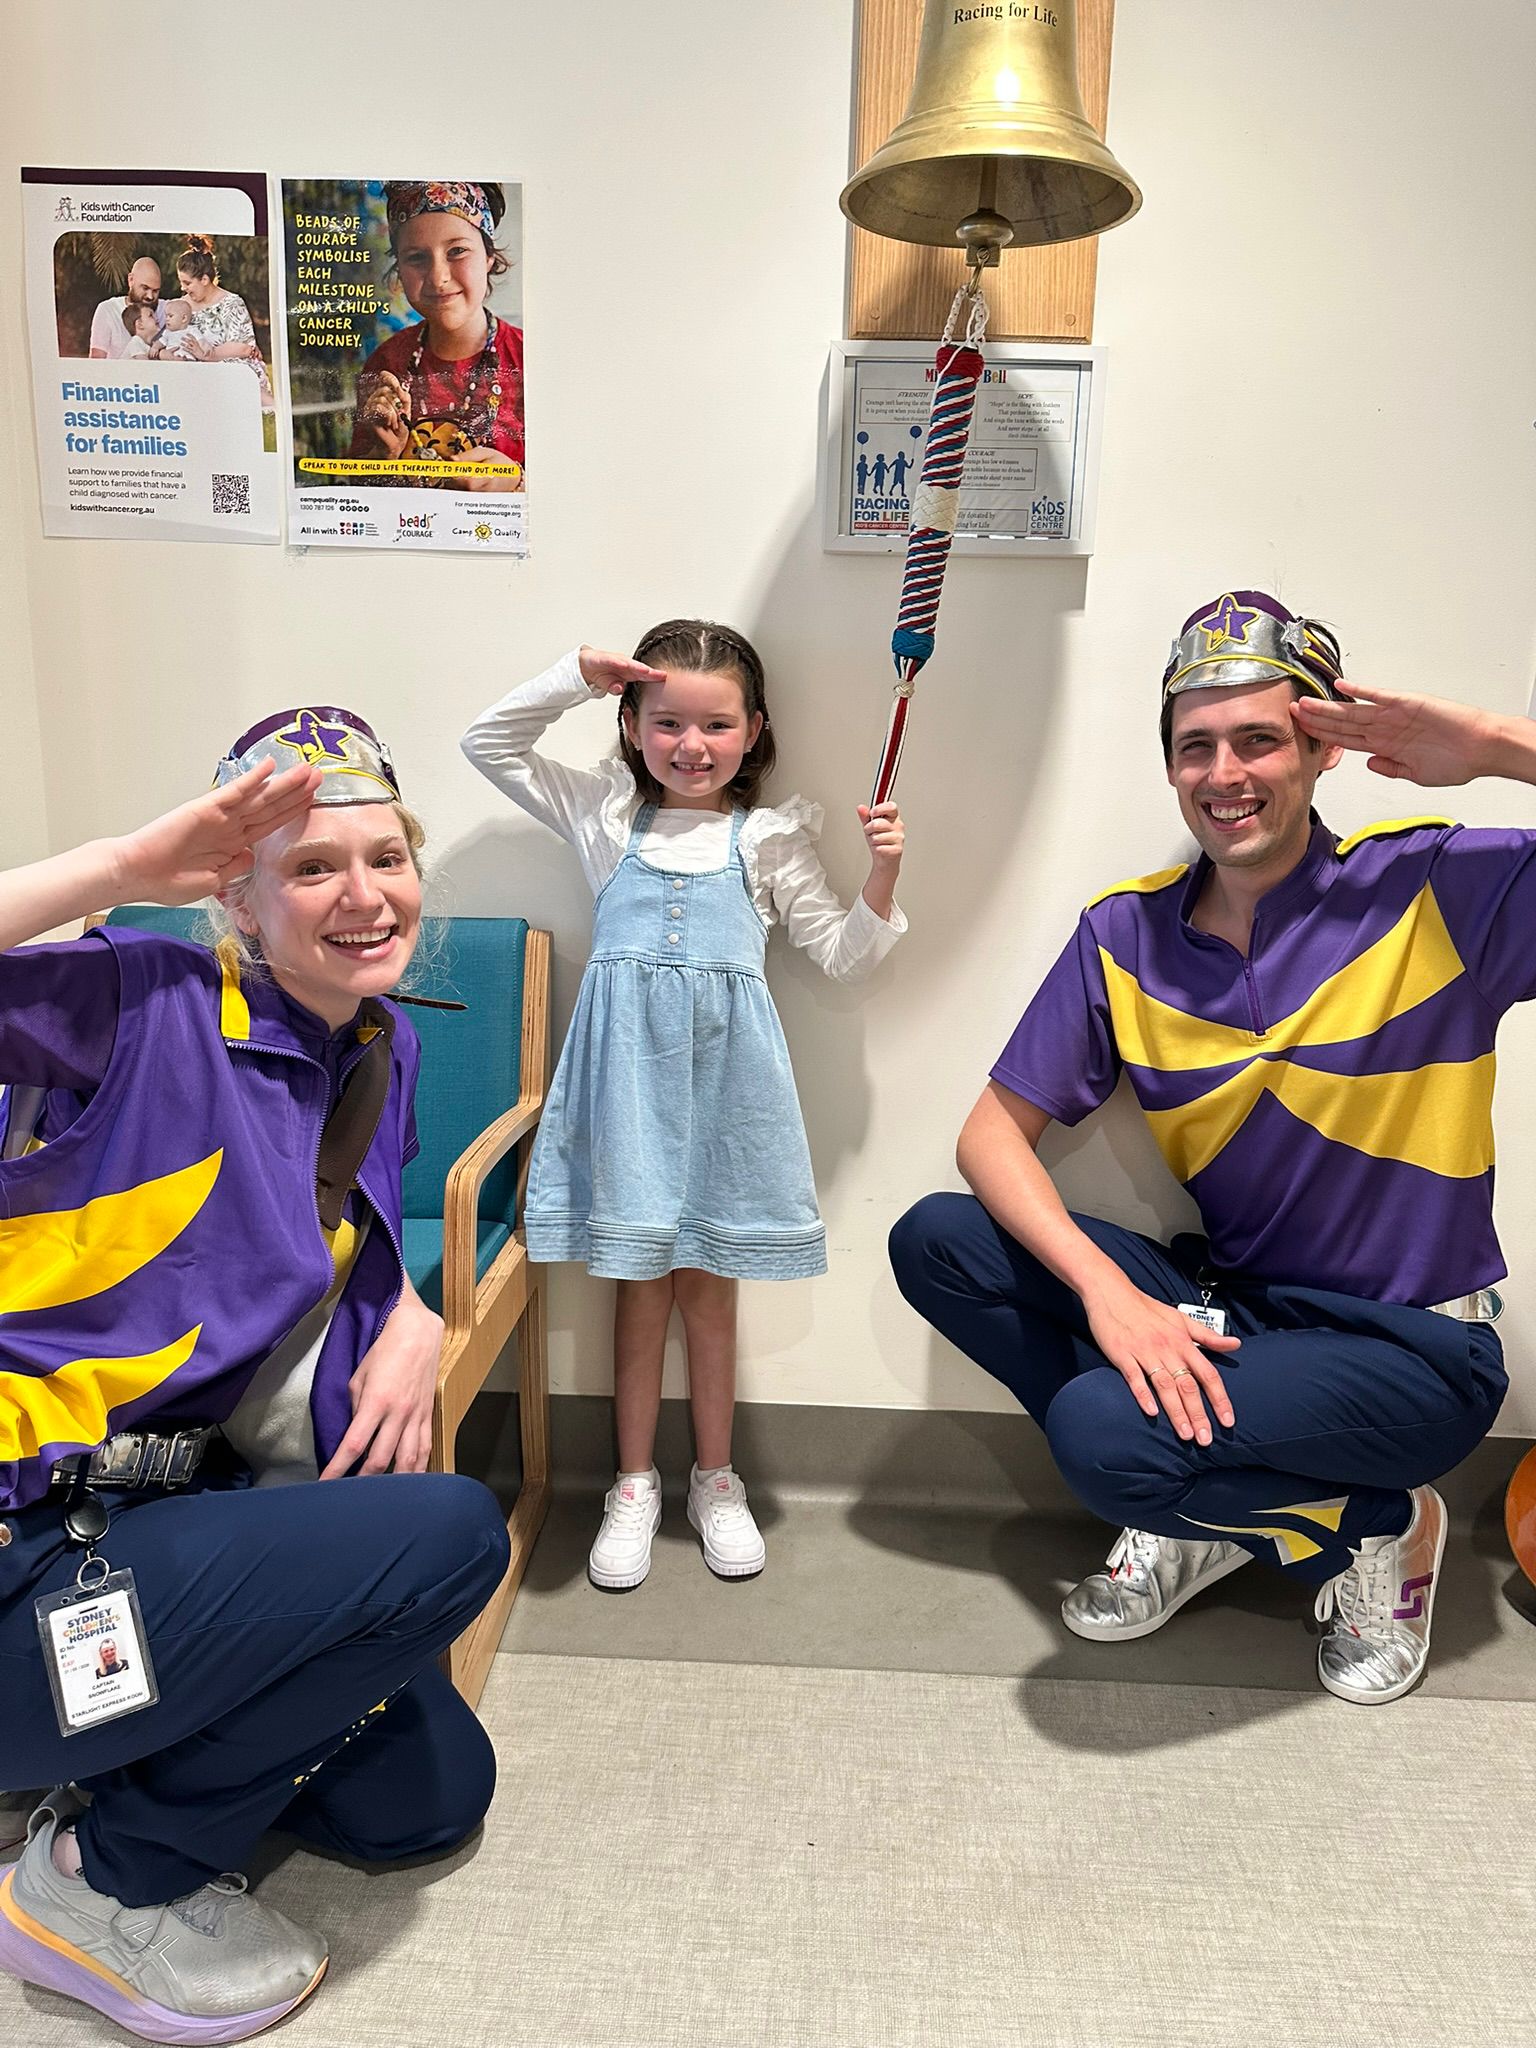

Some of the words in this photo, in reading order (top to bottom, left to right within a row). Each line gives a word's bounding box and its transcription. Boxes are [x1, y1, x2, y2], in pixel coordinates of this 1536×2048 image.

[954, 3, 1003, 25] Racing
[1009, 2, 1030, 17] for
[1034, 5, 1058, 27] Life
[81, 202, 100, 211] Kids
[101, 202, 121, 211] with
[122, 203, 155, 212] Cancer
[81, 213, 132, 222] Foundation
[296, 214, 337, 228] BEADS
[344, 216, 360, 229] OF
[297, 233, 357, 245] COURAGE
[298, 250, 370, 263] SYMBOLISE
[298, 267, 331, 279] EACH
[298, 284, 374, 298] MILESTONE
[298, 300, 318, 313] ON
[324, 301, 333, 313] A
[340, 301, 390, 314] CHILD'S
[299, 318, 352, 330] CANCER
[300, 333, 362, 348] JOURNEY.
[984, 370, 1006, 384] Bell
[62, 382, 160, 403] Financial
[64, 409, 181, 431] assistance
[66, 433, 97, 453] for
[102, 434, 187, 457] families
[91, 468, 107, 476] how
[122, 469, 150, 478] provide
[151, 470, 183, 478] financial
[402, 464, 440, 472] THERAPIST
[492, 467, 515, 475] MORE!
[69, 479, 100, 487] support
[111, 479, 142, 488] families
[144, 480, 159, 488] that
[161, 481, 179, 489] have
[70, 489, 88, 497] child
[90, 490, 130, 499] diagnosed
[300, 497, 360, 505] campquality.org.au
[854, 498, 910, 510] RACING
[70, 504, 155, 515] kidswithcancer.org.au
[467, 510, 521, 518] beadsofcourage.org
[967, 511, 988, 519] donated
[989, 512, 996, 520] by
[400, 513, 431, 529] beads
[854, 511, 880, 521] FOR
[883, 512, 910, 522] LIFE
[978, 521, 990, 529] Life
[313, 527, 320, 535] in
[340, 528, 365, 536] SCHF
[402, 530, 433, 538] COURAGE
[452, 528, 473, 536] Camp
[494, 529, 521, 538] Quality
[1188, 1313, 1215, 1322] SYDNEY
[68, 1607, 112, 1628] SYDNEY
[63, 1614, 121, 1638] CHILDREN'S
[69, 1623, 118, 1644] HOSPITAL
[92, 1680, 115, 1690] CAPTAIN
[88, 1684, 121, 1699] SNOWFLAKE
[72, 1705, 101, 1719] STARLIGHT
[102, 1697, 126, 1709] EXPRESS
[127, 1692, 143, 1700] ROOM
